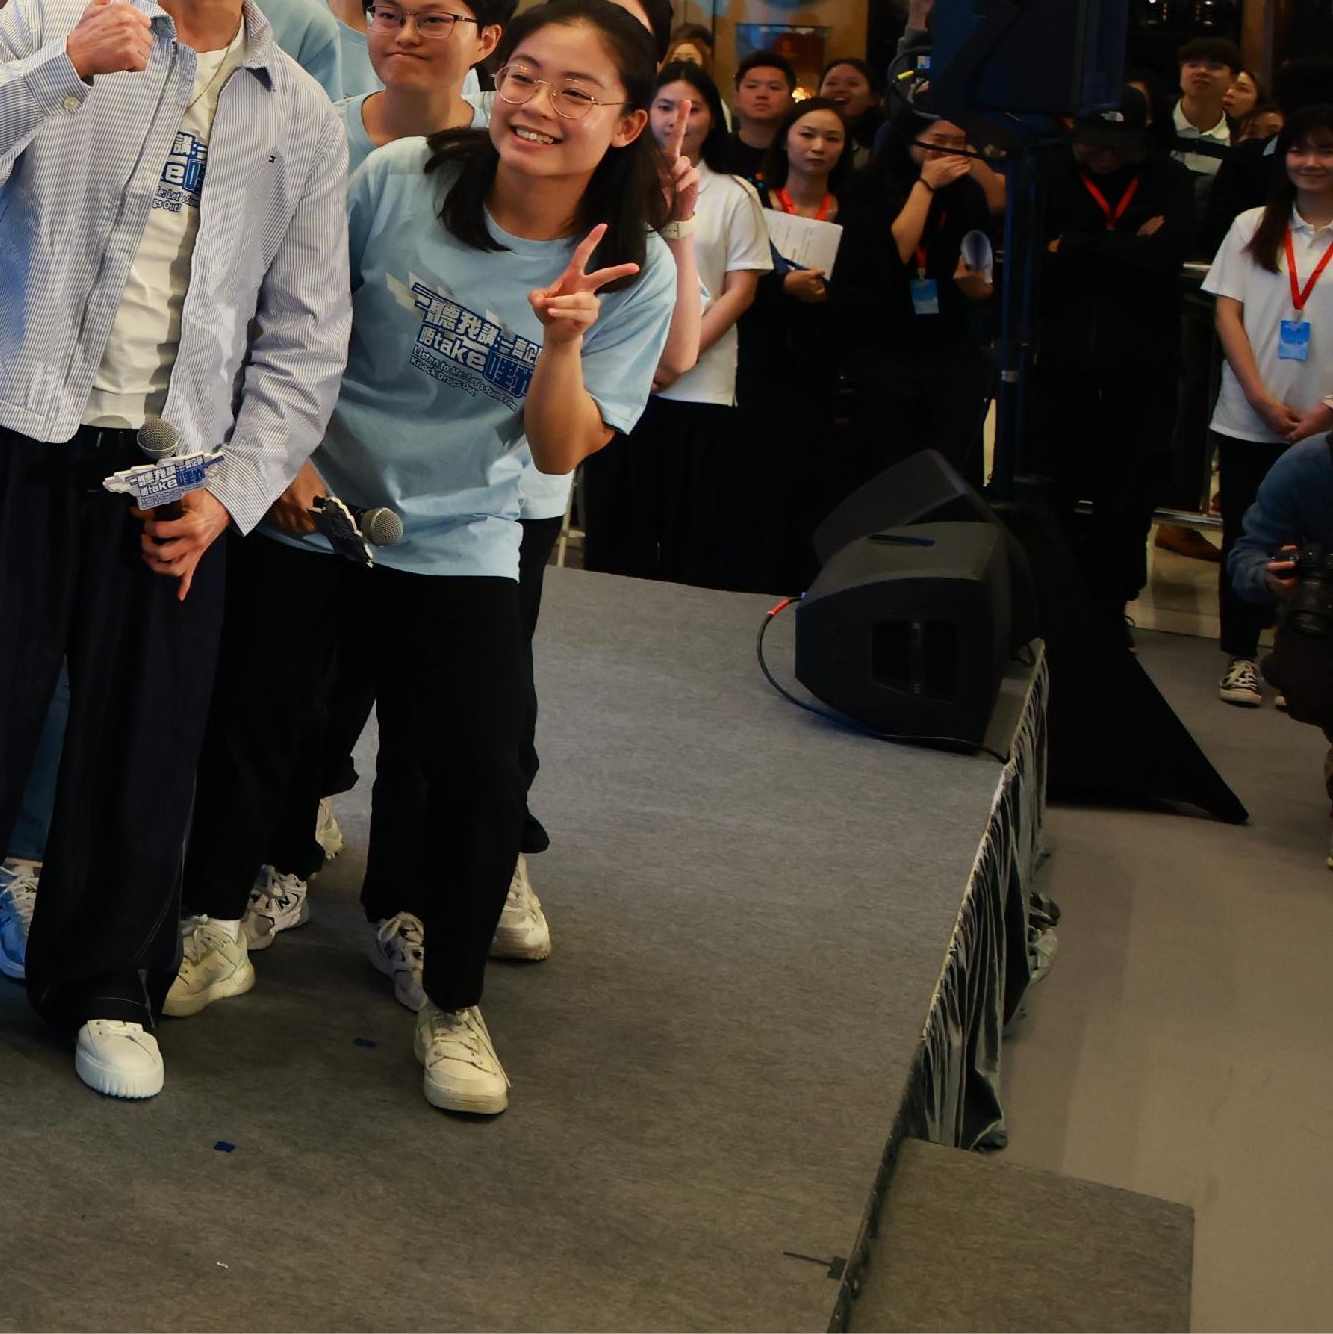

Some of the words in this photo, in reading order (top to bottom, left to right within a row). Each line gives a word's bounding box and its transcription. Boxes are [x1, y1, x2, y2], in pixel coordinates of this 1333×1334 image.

[410, 356, 437, 377] Knock
[412, 345, 440, 366] Listen
[440, 361, 450, 372] to
